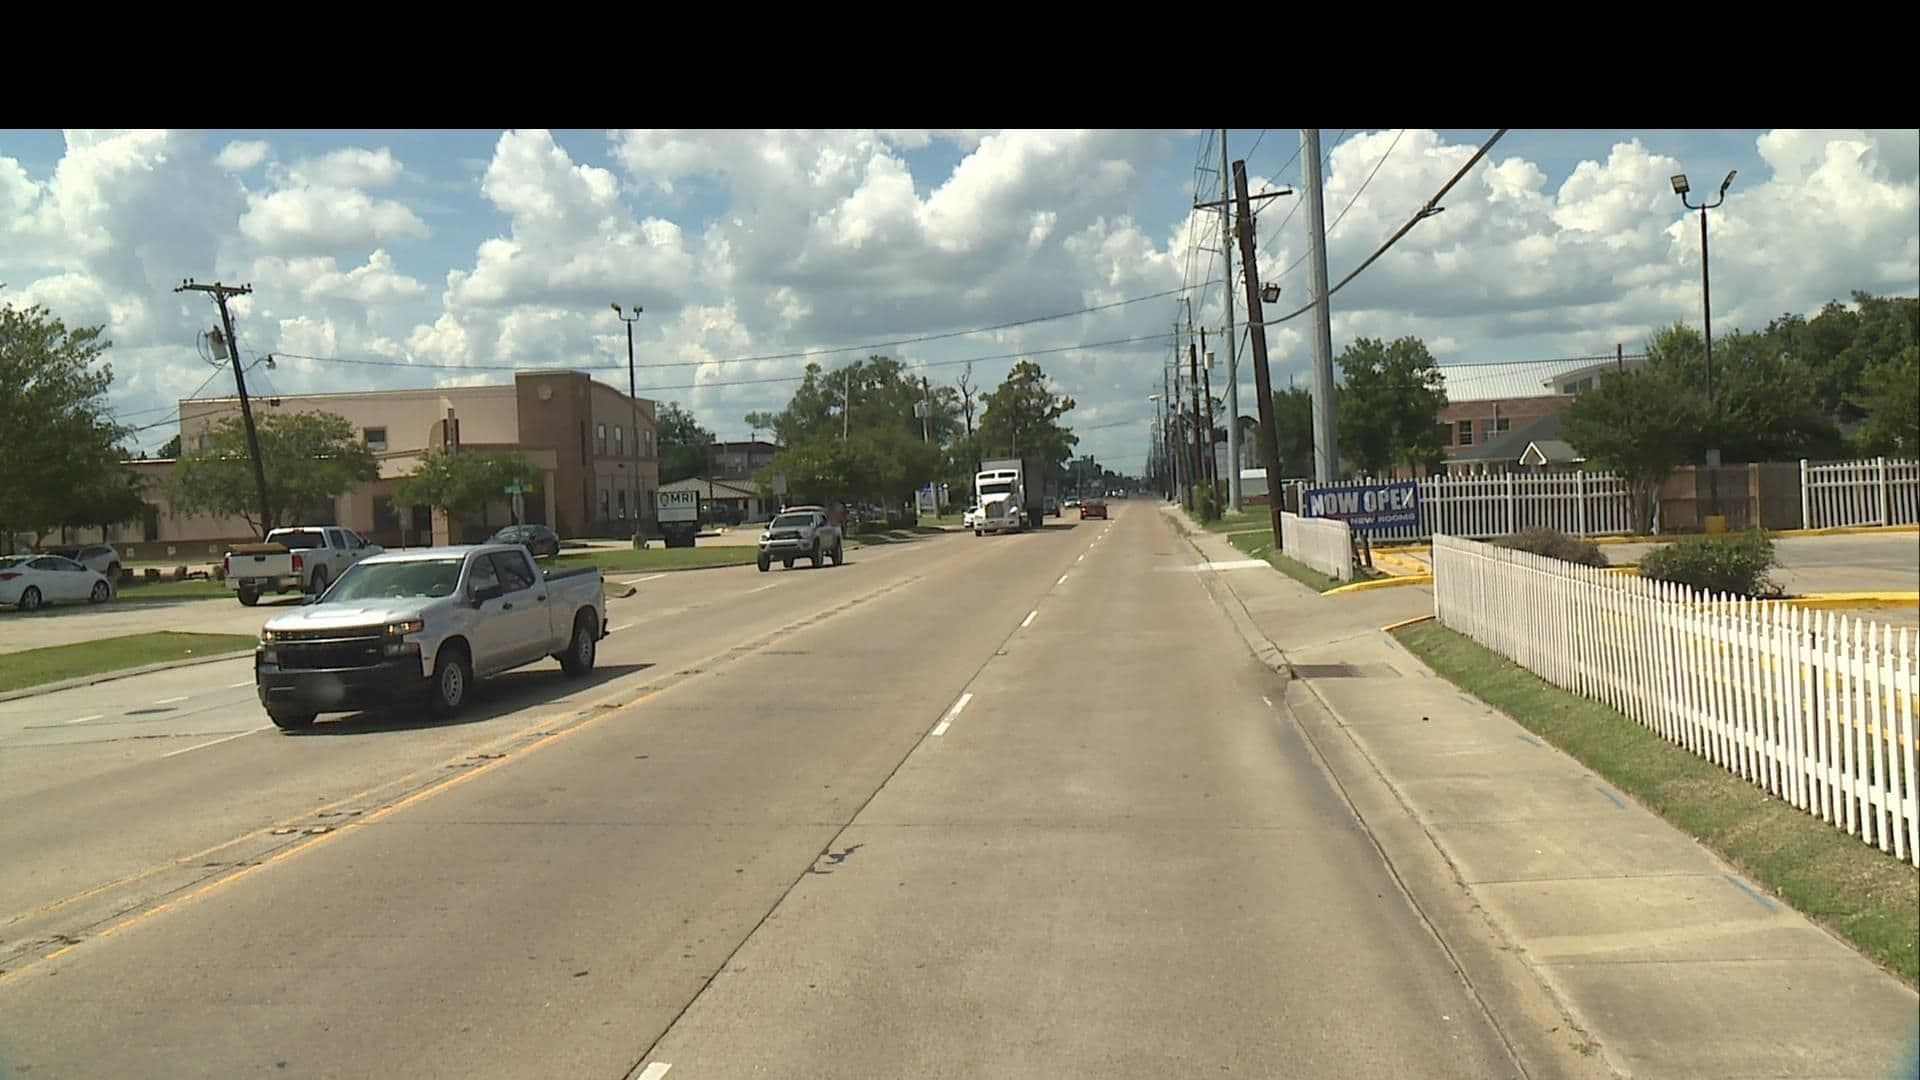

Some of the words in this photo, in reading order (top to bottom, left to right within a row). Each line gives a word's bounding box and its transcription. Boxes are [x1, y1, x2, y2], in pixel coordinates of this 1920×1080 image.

[1311, 492, 1359, 516] NOW
[1363, 487, 1415, 513] OPEN
[1377, 513, 1416, 522] ROOMS
